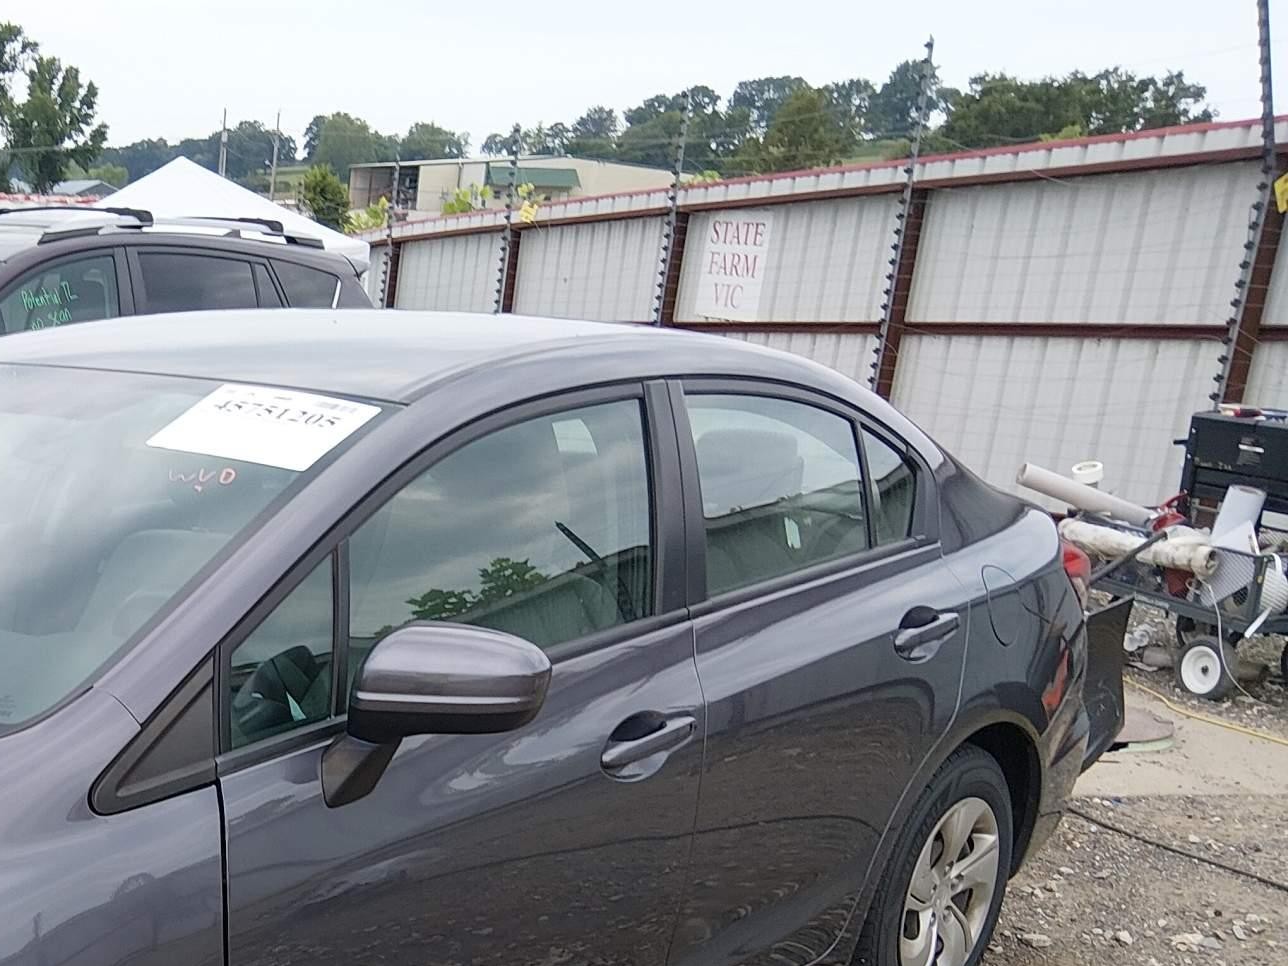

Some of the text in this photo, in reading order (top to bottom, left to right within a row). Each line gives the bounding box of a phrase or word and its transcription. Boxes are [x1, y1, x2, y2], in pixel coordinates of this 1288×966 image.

[710, 219, 767, 247] STATE
[707, 250, 759, 279] FARM
[713, 281, 745, 309] VIC
[214, 399, 342, 428] 45751205
